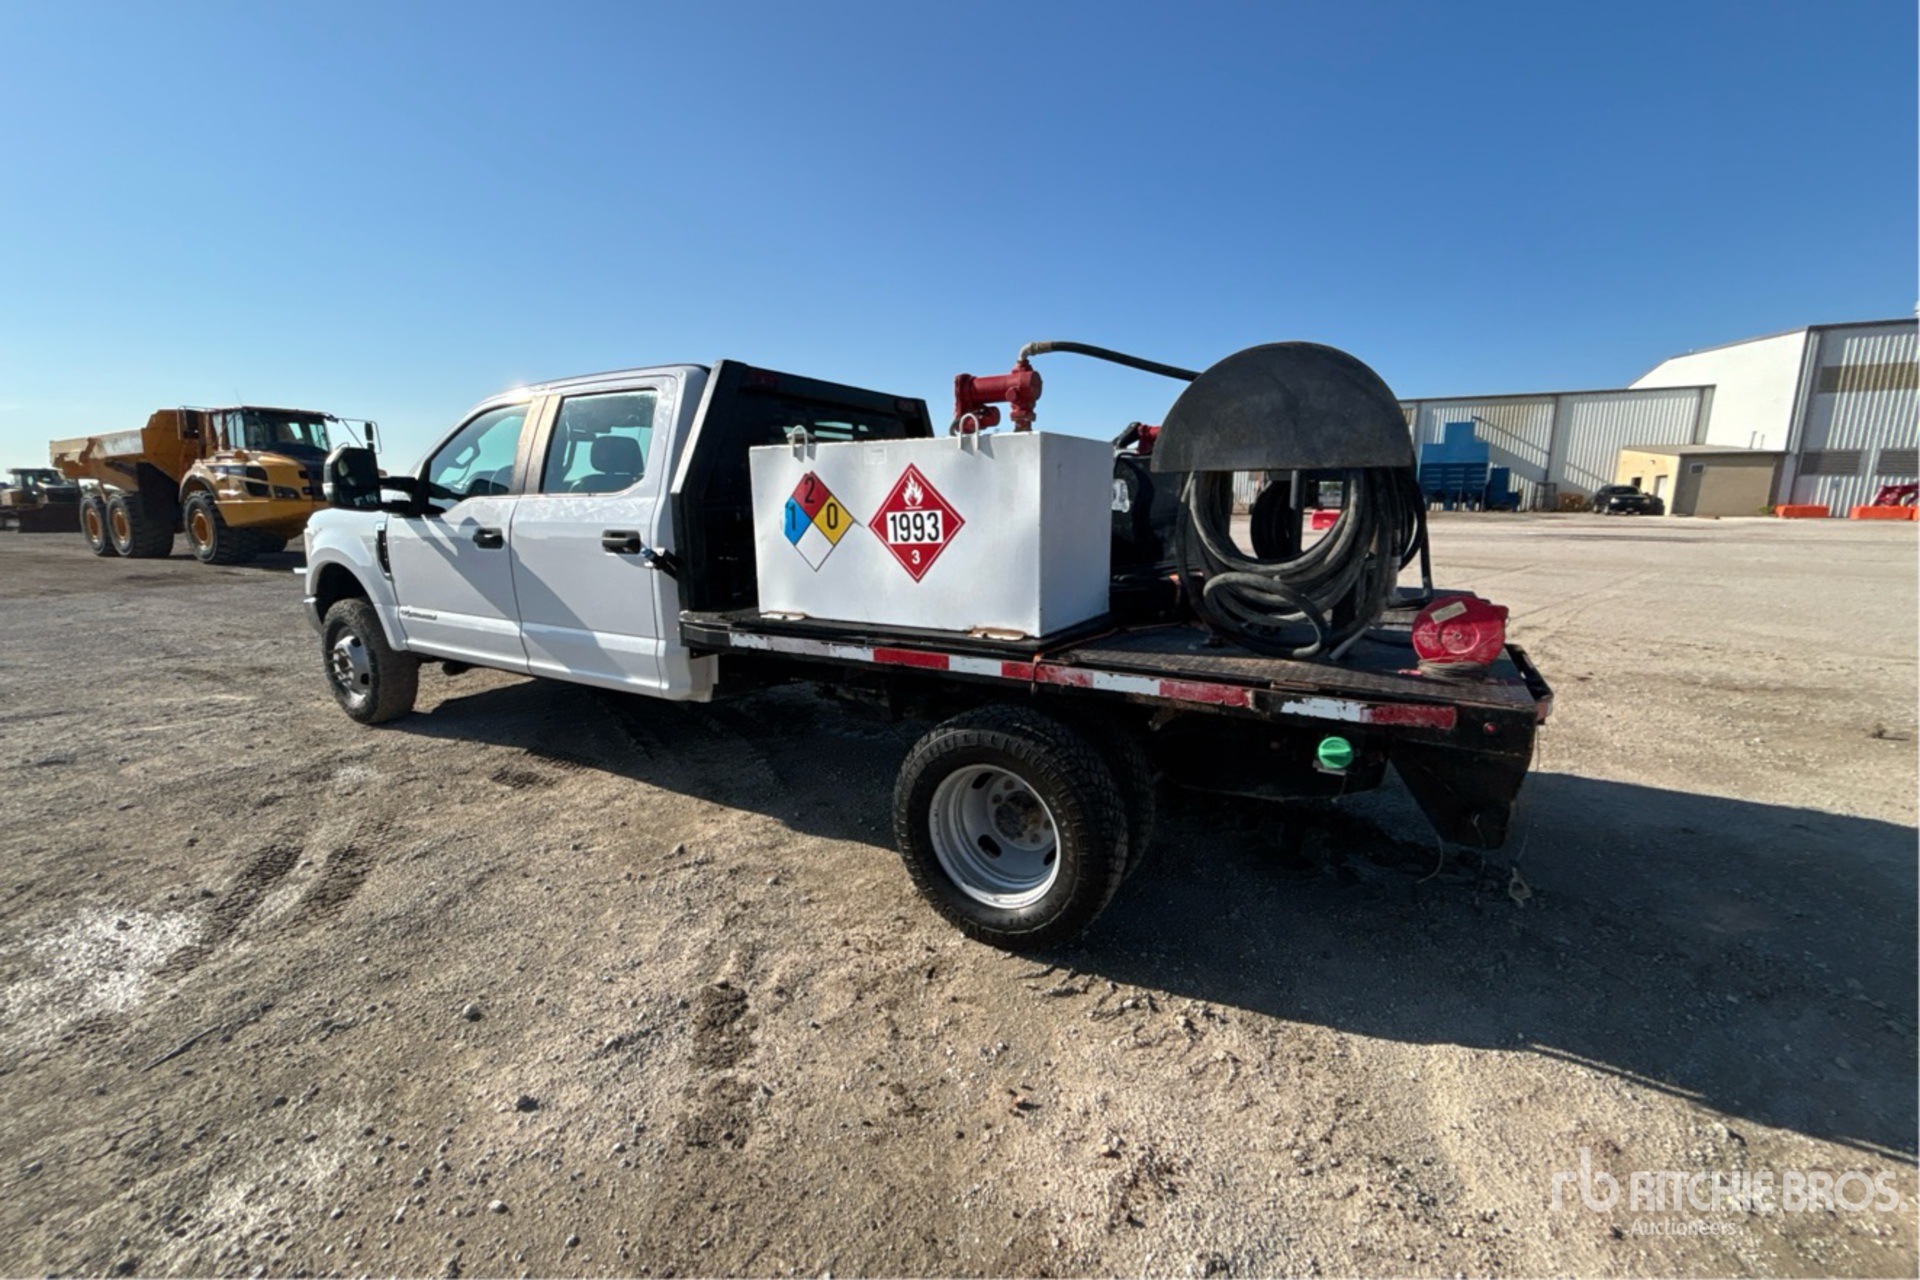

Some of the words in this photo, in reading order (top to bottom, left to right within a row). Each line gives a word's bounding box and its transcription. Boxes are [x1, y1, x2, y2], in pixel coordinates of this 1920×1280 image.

[804, 476, 815, 504] 2
[789, 504, 796, 531] 1
[826, 502, 838, 530] 0
[889, 511, 940, 542] 1993
[911, 549, 921, 565] 3
